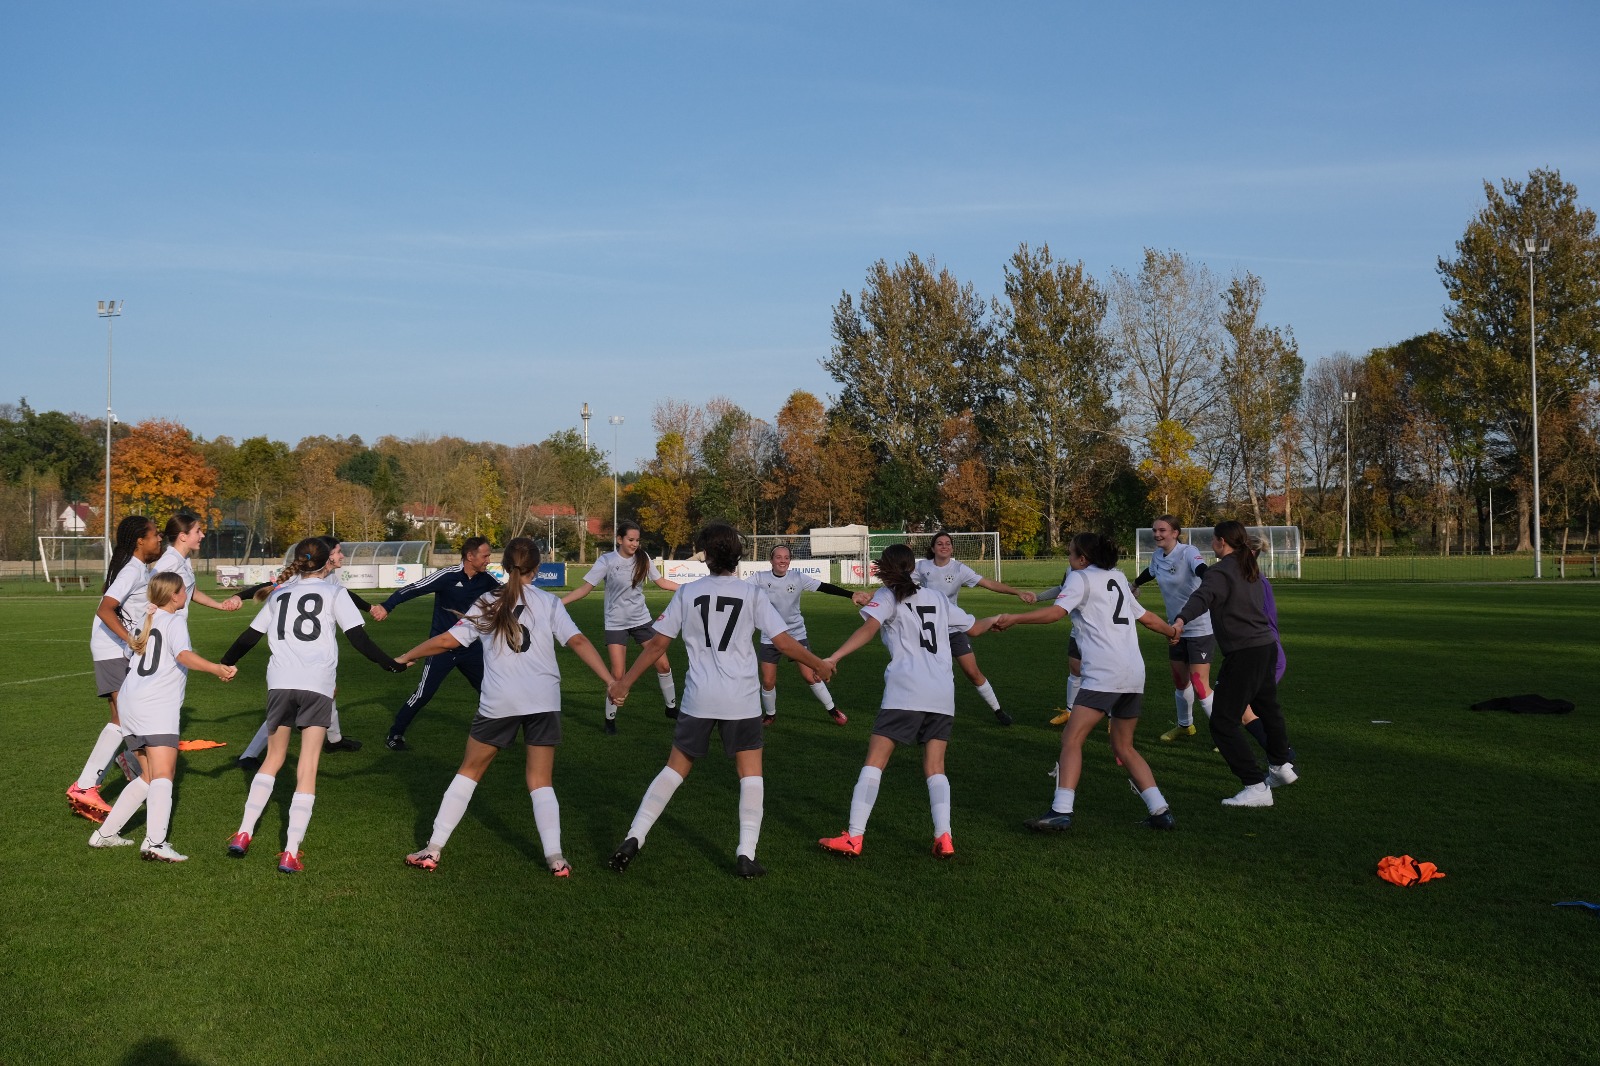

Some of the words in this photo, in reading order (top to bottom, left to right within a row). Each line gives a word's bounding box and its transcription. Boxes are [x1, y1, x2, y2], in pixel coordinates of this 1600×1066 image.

[276, 592, 324, 642] 18
[694, 595, 743, 652] 17
[1106, 578, 1129, 625] 2
[905, 603, 938, 655] 5
